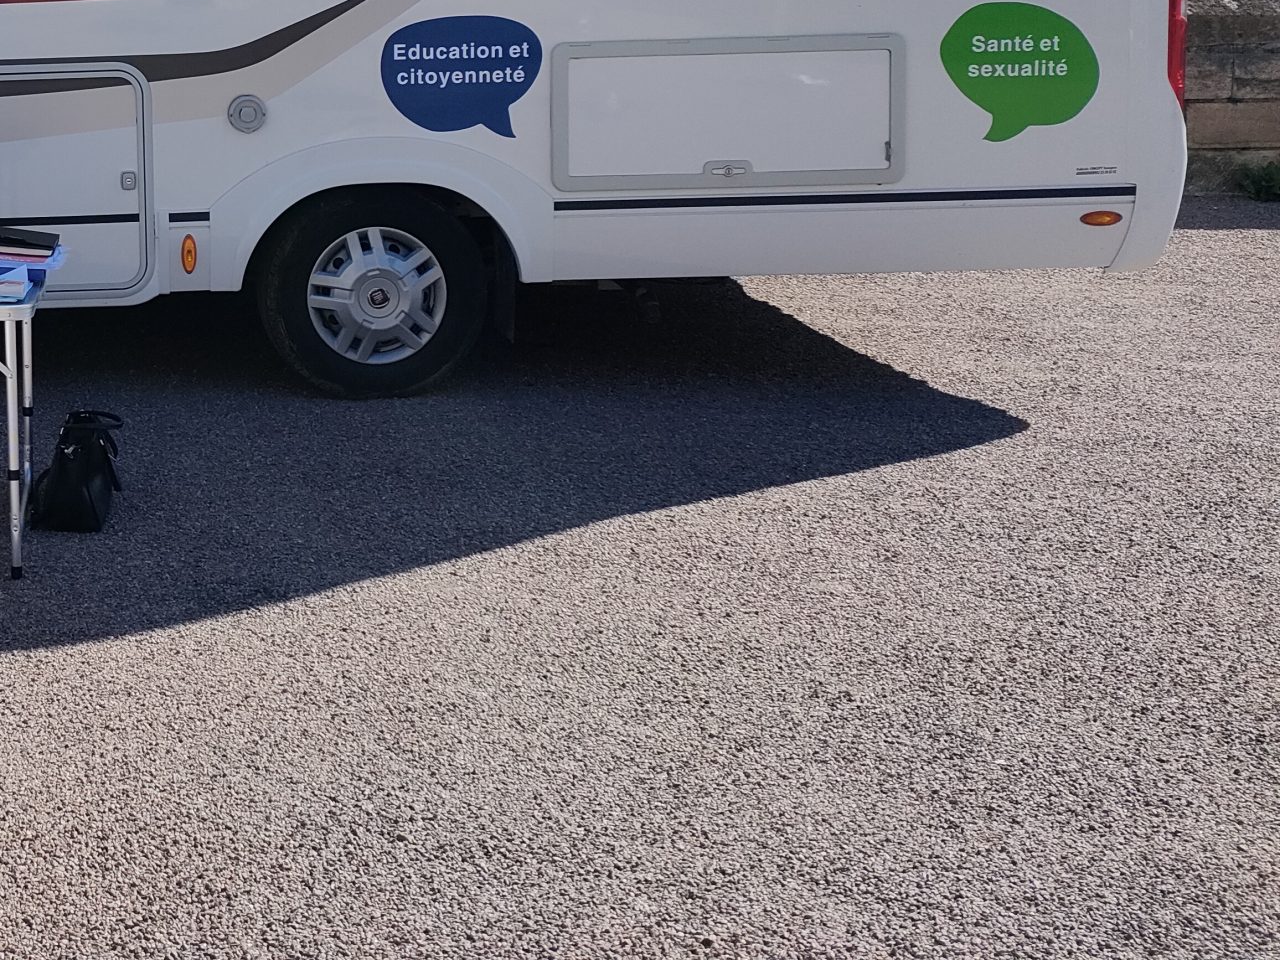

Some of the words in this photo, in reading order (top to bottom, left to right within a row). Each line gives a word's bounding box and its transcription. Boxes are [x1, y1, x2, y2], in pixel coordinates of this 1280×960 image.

[393, 42, 503, 61] Education
[508, 41, 530, 58] et
[971, 34, 1034, 53] Santé
[1039, 35, 1060, 52] et
[396, 65, 526, 89] citoyenneté
[967, 58, 1068, 78] sexualité
